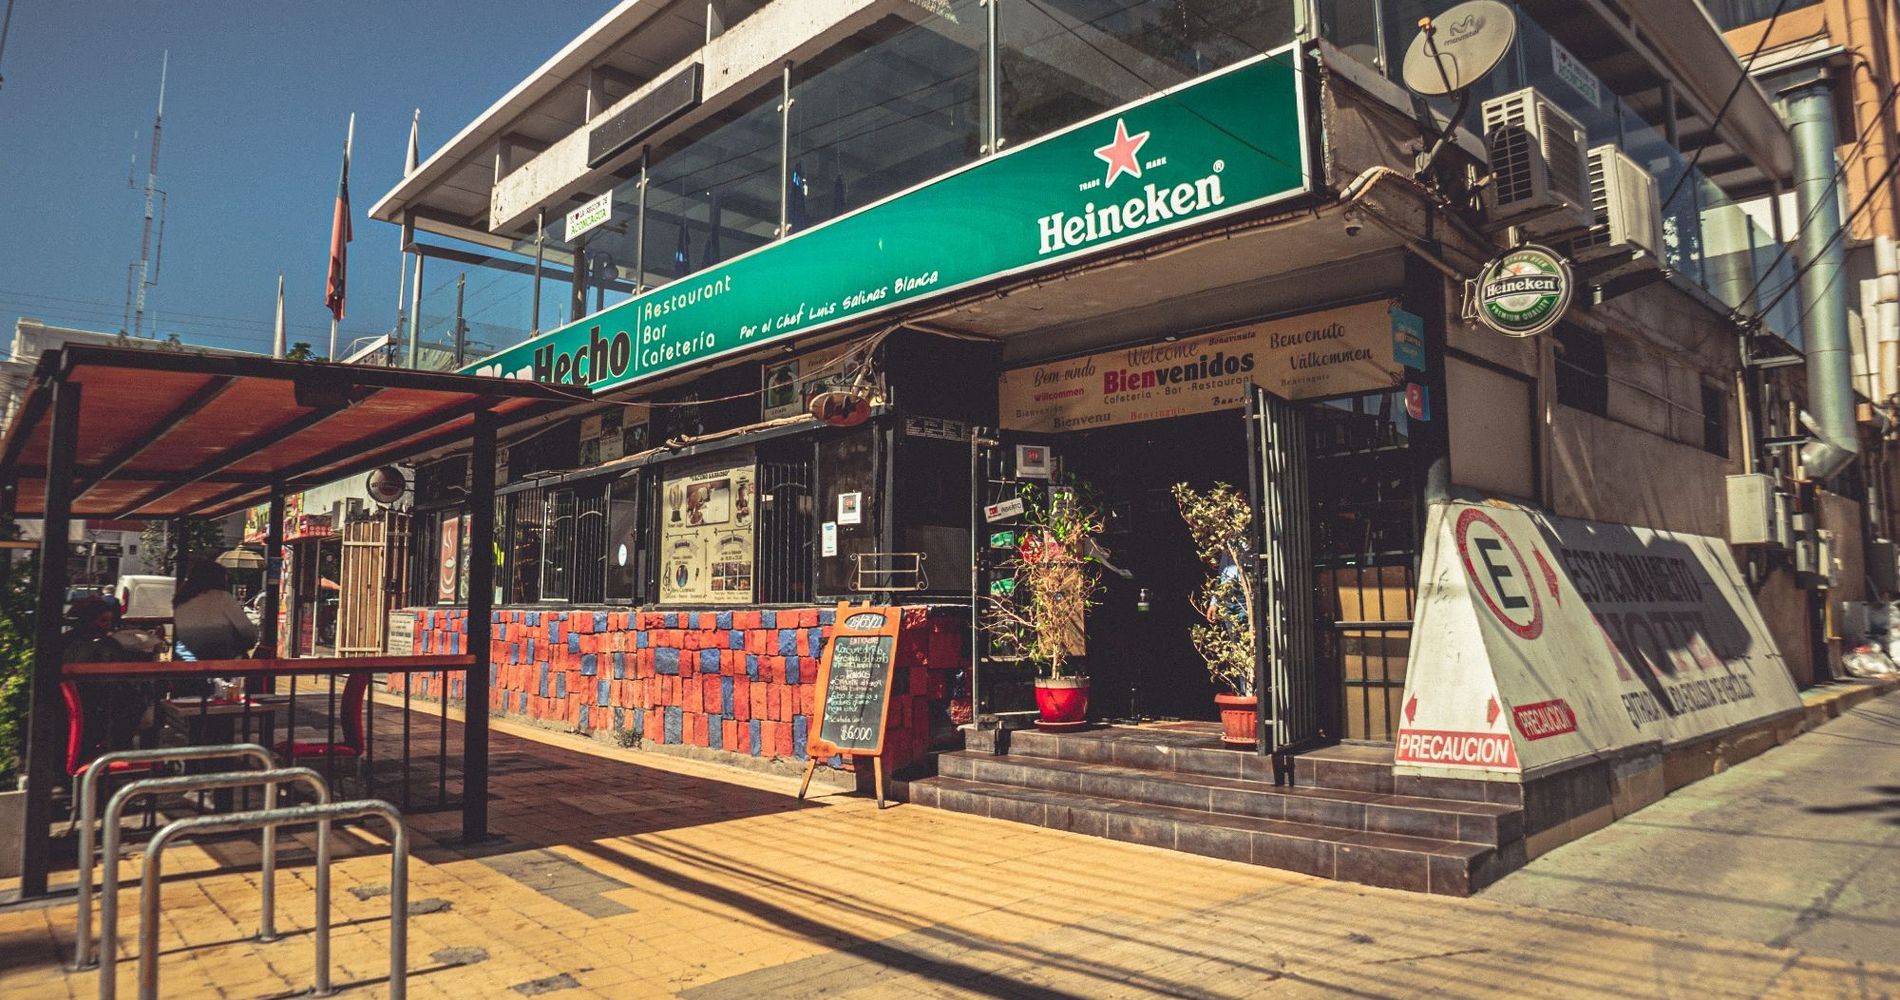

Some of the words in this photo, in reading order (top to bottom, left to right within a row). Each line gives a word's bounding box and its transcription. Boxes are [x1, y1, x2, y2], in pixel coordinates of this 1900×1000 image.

[1079, 178, 1101, 192] TRADE
[1145, 156, 1167, 170] MARK
[1037, 172, 1226, 255] Heineken
[645, 275, 731, 321] Restaurant
[1486, 278, 1555, 297] Heineken
[739, 325, 758, 339] Por
[761, 318, 772, 332] el
[776, 302, 806, 330] Chef
[808, 302, 837, 320] Luis
[842, 286, 888, 310] Salinas
[1491, 304, 1520, 320] PREMIUM
[1522, 299, 1551, 320] QUALITY
[642, 331, 715, 367] Cafetería
[643, 324, 667, 344] Bar
[1270, 321, 1346, 350] Benvenuto
[534, 325, 631, 386] Hecho
[1127, 342, 1201, 367] Welcome
[1290, 347, 1373, 370] Välkommen
[1103, 352, 1255, 395] Bienvenidos
[1165, 387, 1182, 396] Bar
[1053, 413, 1111, 428] Bienvenu
[1473, 538, 1530, 609] E
[1560, 548, 1702, 603] ESTACIONAMIENTO
[1517, 702, 1572, 736] PRECAUCION
[1398, 734, 1510, 764] PRECAUCION
